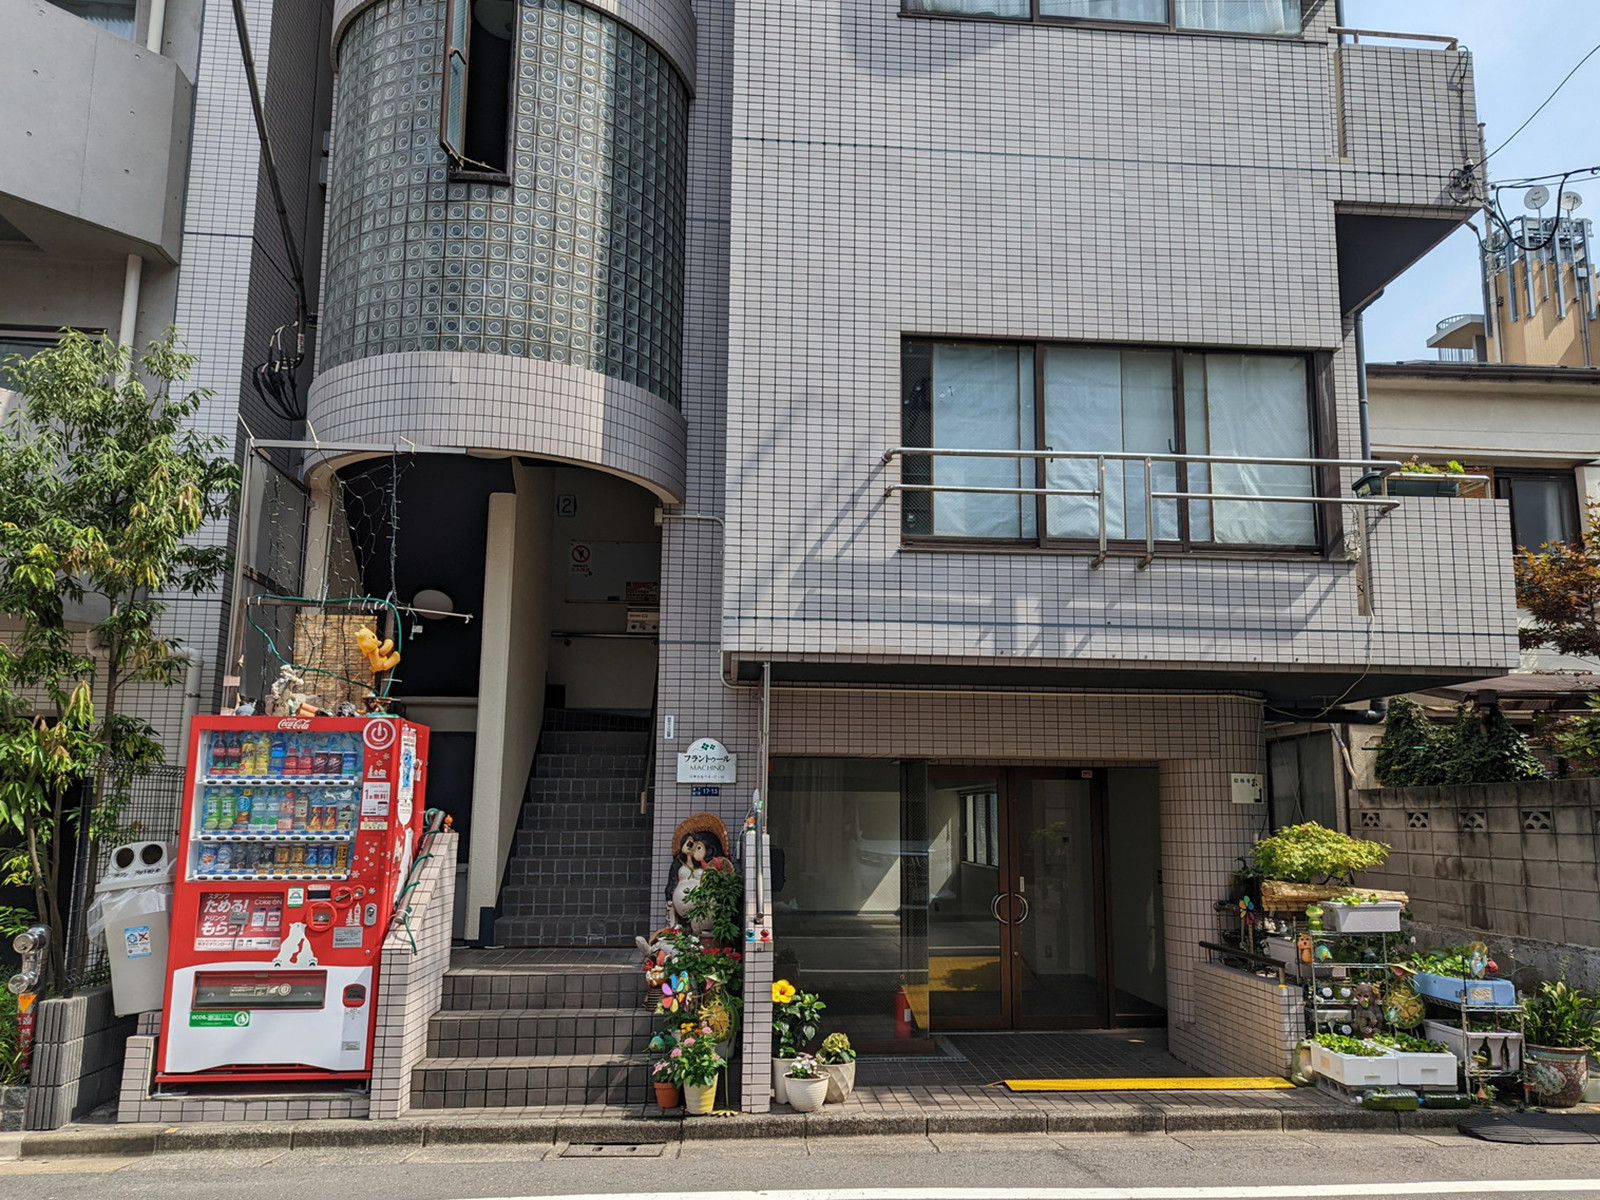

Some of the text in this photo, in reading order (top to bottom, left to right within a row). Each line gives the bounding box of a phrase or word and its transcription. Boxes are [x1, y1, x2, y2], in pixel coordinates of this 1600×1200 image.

[561, 498, 572, 514] 2
[277, 718, 312, 730] Coca-Cola
[684, 754, 731, 763] フラントゥール
[203, 899, 249, 913] ためる!
